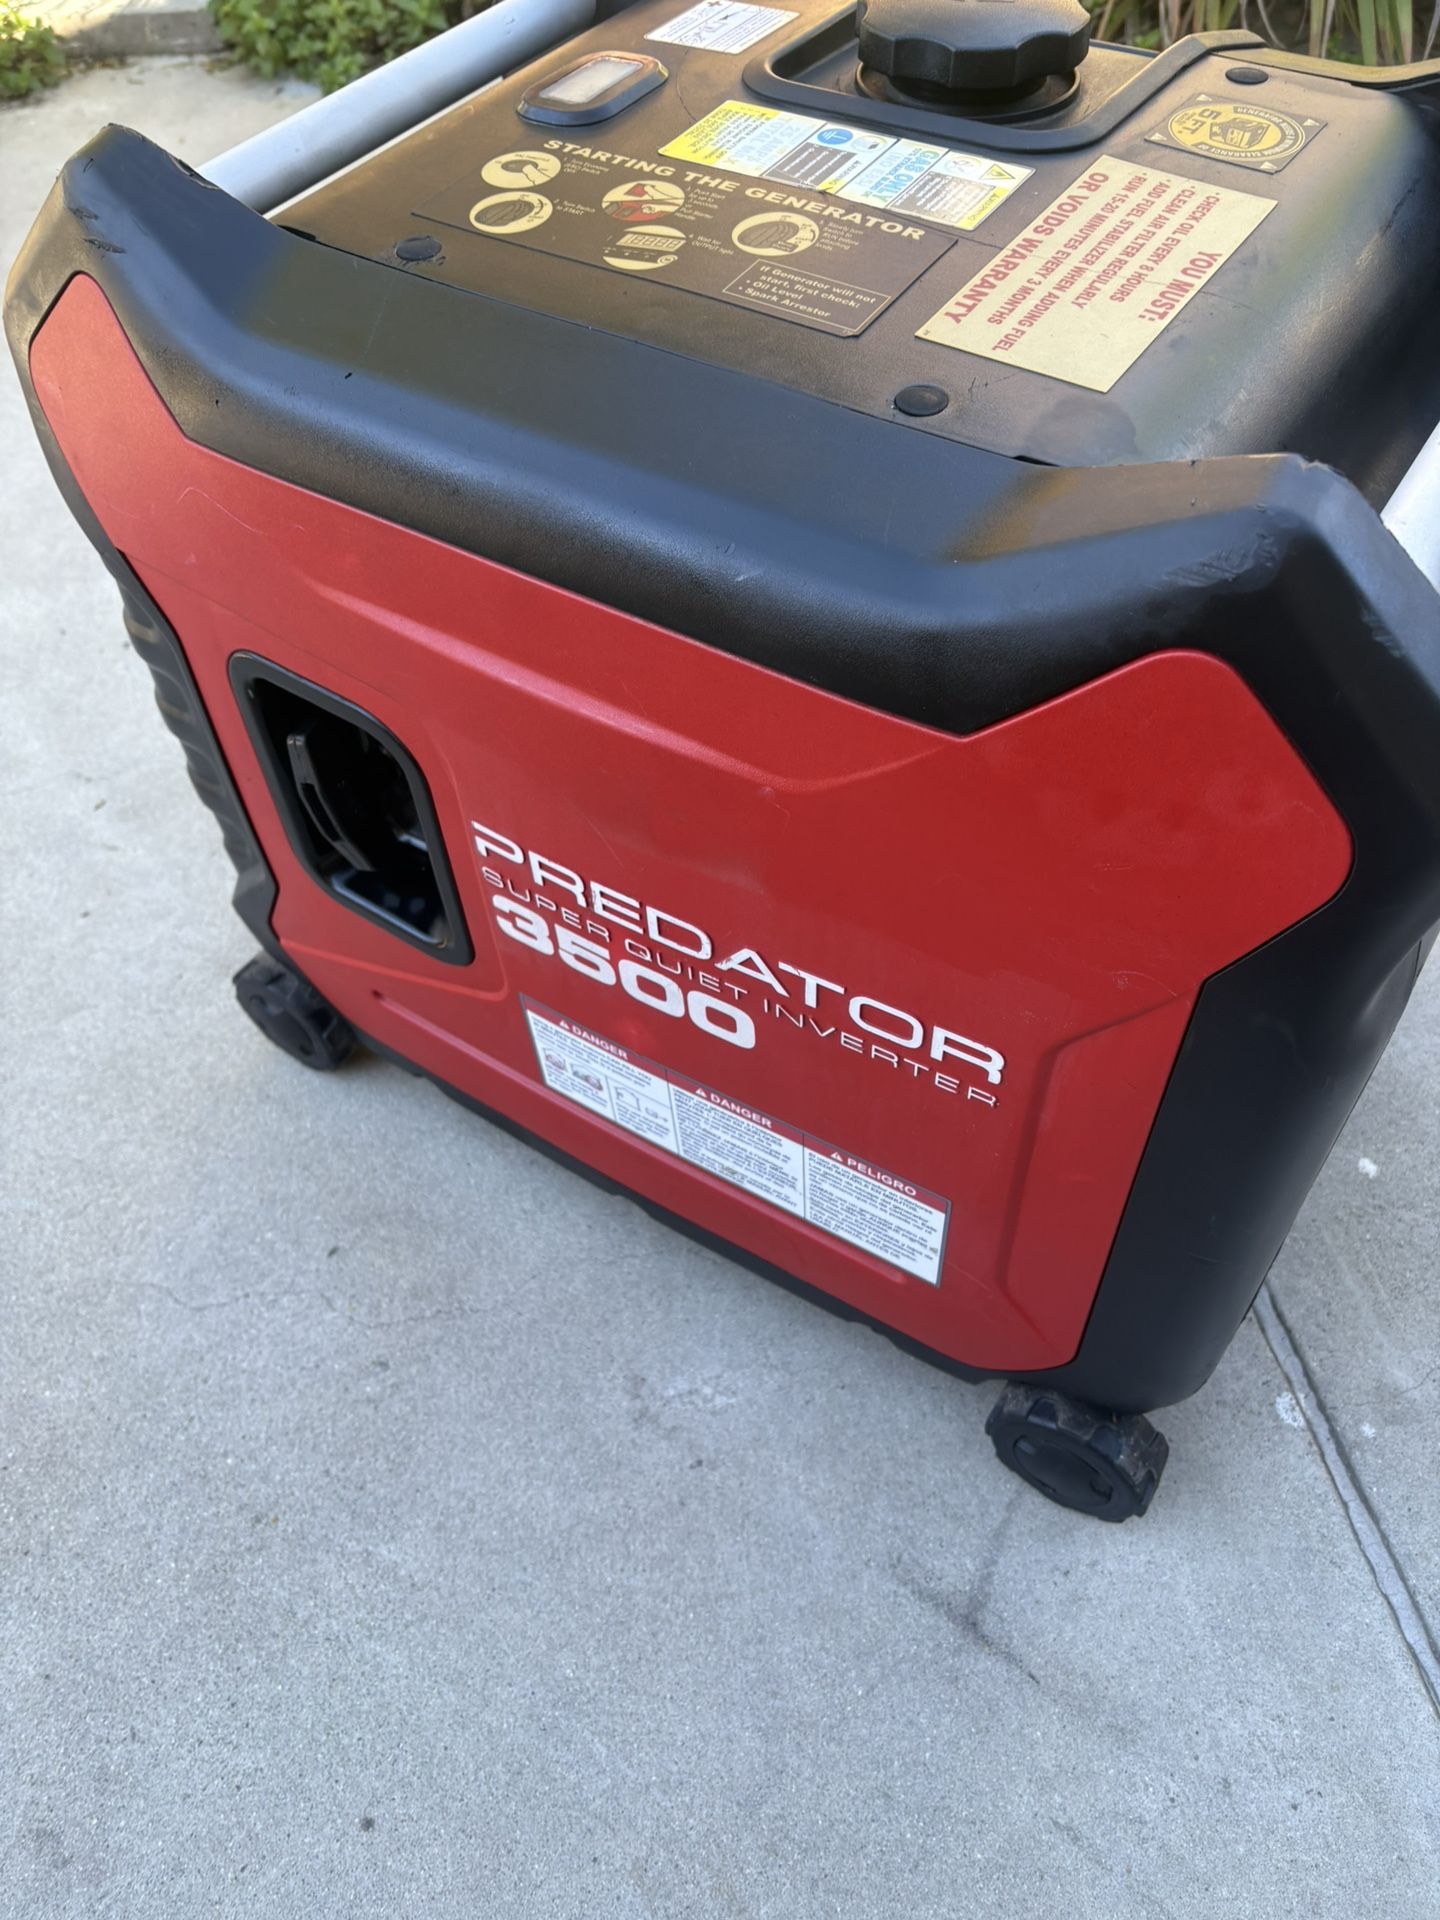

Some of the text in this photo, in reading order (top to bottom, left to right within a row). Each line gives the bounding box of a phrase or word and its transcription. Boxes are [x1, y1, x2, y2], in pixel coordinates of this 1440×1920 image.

[901, 149, 944, 173] GAS
[544, 140, 676, 176] STARTING
[684, 171, 740, 192] THE
[745, 187, 927, 241] GENERATOR
[865, 172, 917, 202] ONLY
[1173, 222, 1194, 235] OIL
[1187, 196, 1220, 224] CHECK
[944, 172, 1110, 324] OR VOIDS WARRANTY
[986, 175, 1146, 326] RUN 15-20 MINUTES EVERY 3 MONTHS
[1072, 188, 1195, 308] CLEAN AIR FILTER REGULARLY
[1148, 236, 1180, 266] EVERY
[760, 265, 876, 304] If Generator will not
[991, 182, 1169, 352] ADD FUEL STABILIZER WHEN ADDING FUEL
[744, 287, 832, 318] Spark Arrestor
[752, 280, 804, 300] Oil Level
[794, 282, 819, 296] first
[1108, 271, 1146, 303] HOURS
[1138, 252, 1223, 322] YOU MUST:
[471, 820, 1006, 1086] PREDATOR
[481, 865, 1000, 1108] SUPER QUIET INVERTER
[491, 894, 756, 1050] 3500
[572, 1025, 629, 1061] DANGER
[710, 1093, 772, 1129] DANGER
[847, 1158, 917, 1197] PELIGRO
